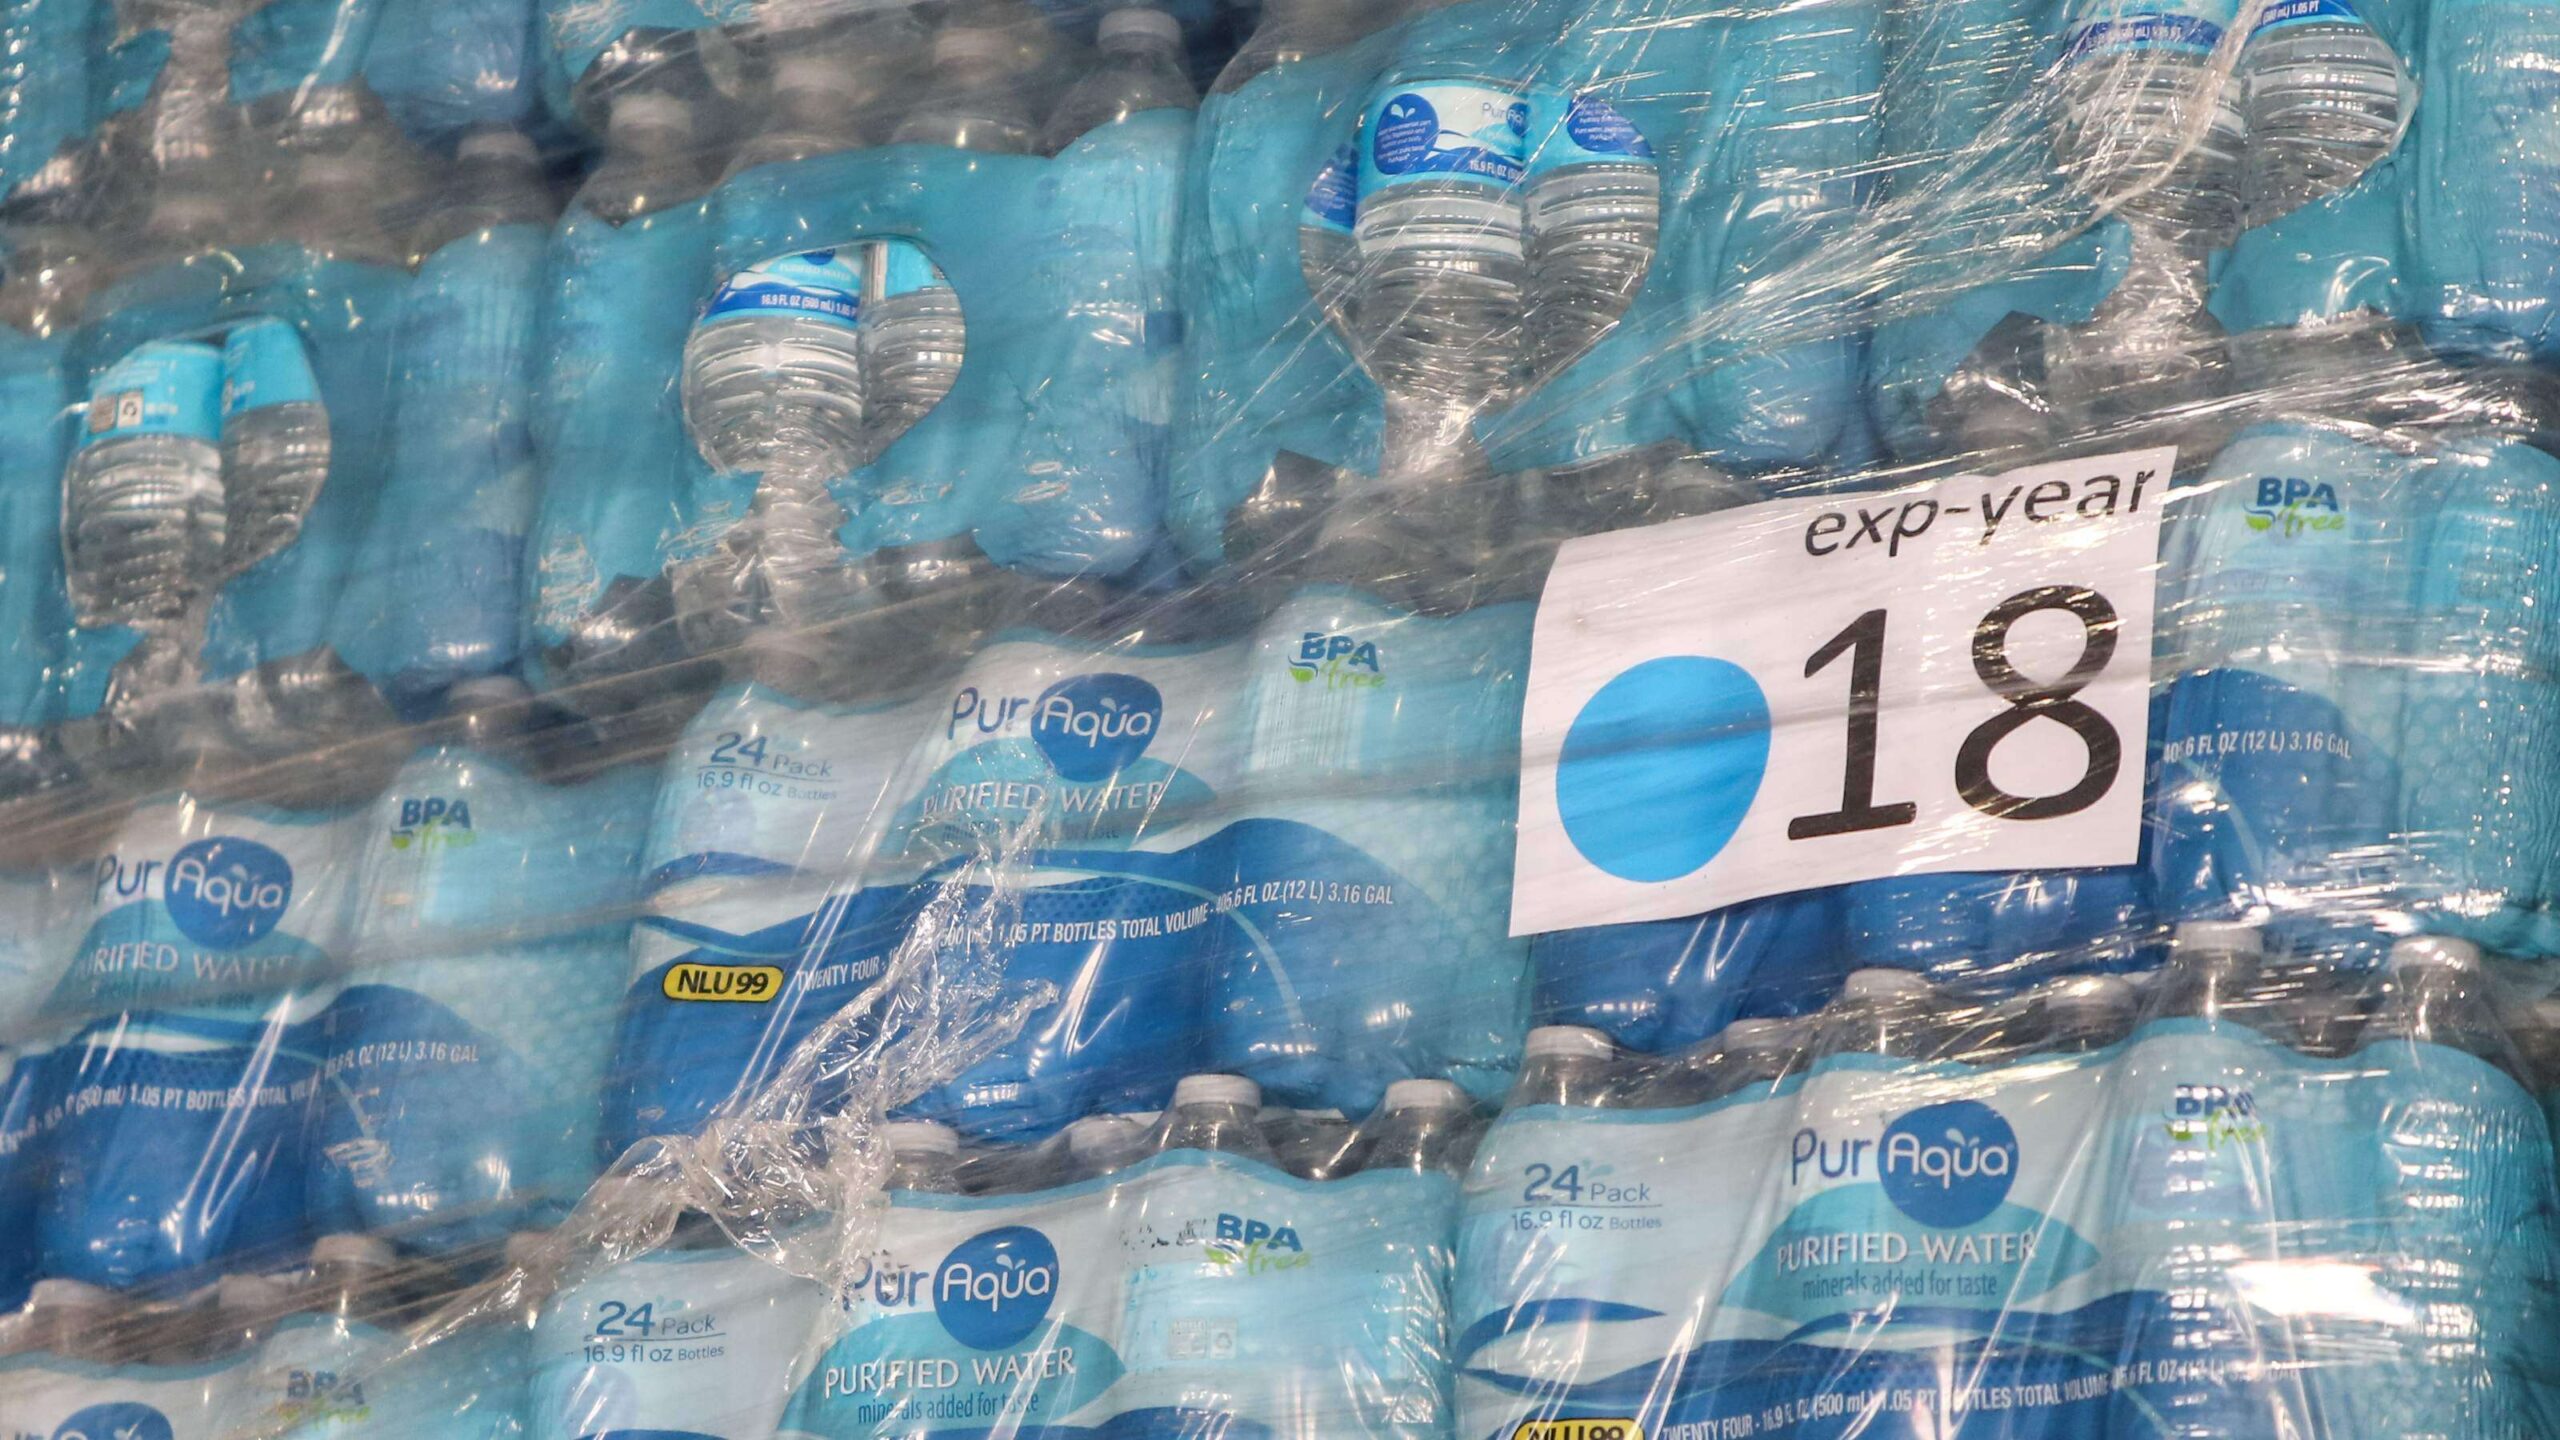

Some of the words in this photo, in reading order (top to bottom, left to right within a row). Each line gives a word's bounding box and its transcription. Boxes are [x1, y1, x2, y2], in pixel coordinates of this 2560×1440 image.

[1804, 467, 2155, 557] exp-year
[2257, 477, 2339, 511] BPA
[2277, 499, 2345, 538] free
[1300, 631, 1379, 672] BPA
[1322, 654, 1387, 691] free
[947, 687, 1029, 740] Pur
[1039, 696, 1152, 748] Aqua
[1788, 584, 2122, 841] 18
[710, 731, 768, 767] 24
[773, 754, 833, 777] Pack
[2198, 734, 2213, 755] FL
[2219, 731, 2239, 754] OZ
[2242, 730, 2265, 754] (12
[2269, 731, 2285, 754] L)
[2289, 731, 2324, 751] 3.16
[2328, 733, 2352, 759] GAL
[697, 771, 734, 789] 16.9
[740, 772, 753, 789] fl
[759, 780, 782, 796] oz
[787, 785, 837, 800] Bottles
[1060, 781, 1166, 813] WATER
[400, 796, 471, 829] BPA
[94, 854, 163, 904] Pur
[173, 858, 283, 917] Aqua
[797, 963, 848, 991] TWENTY
[851, 956, 880, 983] FOUR
[1031, 922, 1051, 943] PT
[1053, 919, 1117, 943] BOTTLES
[1121, 916, 1162, 939] TOTAL
[1165, 902, 1210, 933] VOLUME
[1216, 886, 1242, 915] 405.6
[1244, 884, 1258, 905] FL
[1262, 881, 1280, 904] OZ
[1282, 879, 1305, 904] (12
[1309, 880, 1324, 905] L)
[1328, 881, 1361, 904] 3.16
[1365, 884, 1394, 905] GAL
[676, 969, 770, 995] NLU99
[130, 1083, 161, 1107] 1.05
[163, 1087, 185, 1109] PT
[415, 1041, 446, 1062] 3.16
[450, 1044, 479, 1063] GAL
[1792, 1127, 1872, 1186] Pur
[1887, 1131, 2009, 1190] Aqua
[1524, 1163, 1583, 1202] 24
[1590, 1183, 1650, 1202] Pack
[1216, 1213, 1303, 1252] BPA
[1512, 1210, 1552, 1231] 16.9
[1559, 1210, 1572, 1229] fl
[1579, 1215, 1603, 1230] oz
[1609, 1214, 1662, 1230] Bottles
[1244, 1240, 1312, 1275] free
[1776, 1232, 1908, 1277] PURIFIED
[1921, 1231, 2038, 1264] WATER
[842, 1257, 929, 1311] Pur
[942, 1260, 1051, 1312] Aqua
[1803, 1274, 1866, 1299] minerals
[1872, 1269, 1924, 1296] added
[1928, 1272, 1953, 1296] for
[1958, 1276, 1998, 1297] taste
[596, 1301, 655, 1337] 24
[662, 1314, 716, 1336] Pack
[584, 1345, 624, 1363] 16.9
[630, 1344, 644, 1362] fl
[650, 1349, 673, 1362] oz
[679, 1345, 725, 1361] Bottles
[824, 1359, 960, 1399] PURIFIED
[971, 1347, 1077, 1386] WATER
[927, 1392, 973, 1419] added
[977, 1391, 999, 1416] for
[1723, 1414, 1753, 1440] FOUR
[1763, 1406, 1783, 1431] 16.9
[1813, 1393, 1843, 1420] (500
[1881, 1389, 1912, 1411] 1.05
[2015, 1384, 2061, 1408] TOTAL
[2065, 1372, 2109, 1401] VOLUME
[2139, 1360, 2154, 1384] FL
[2159, 1358, 2178, 1382] OZ
